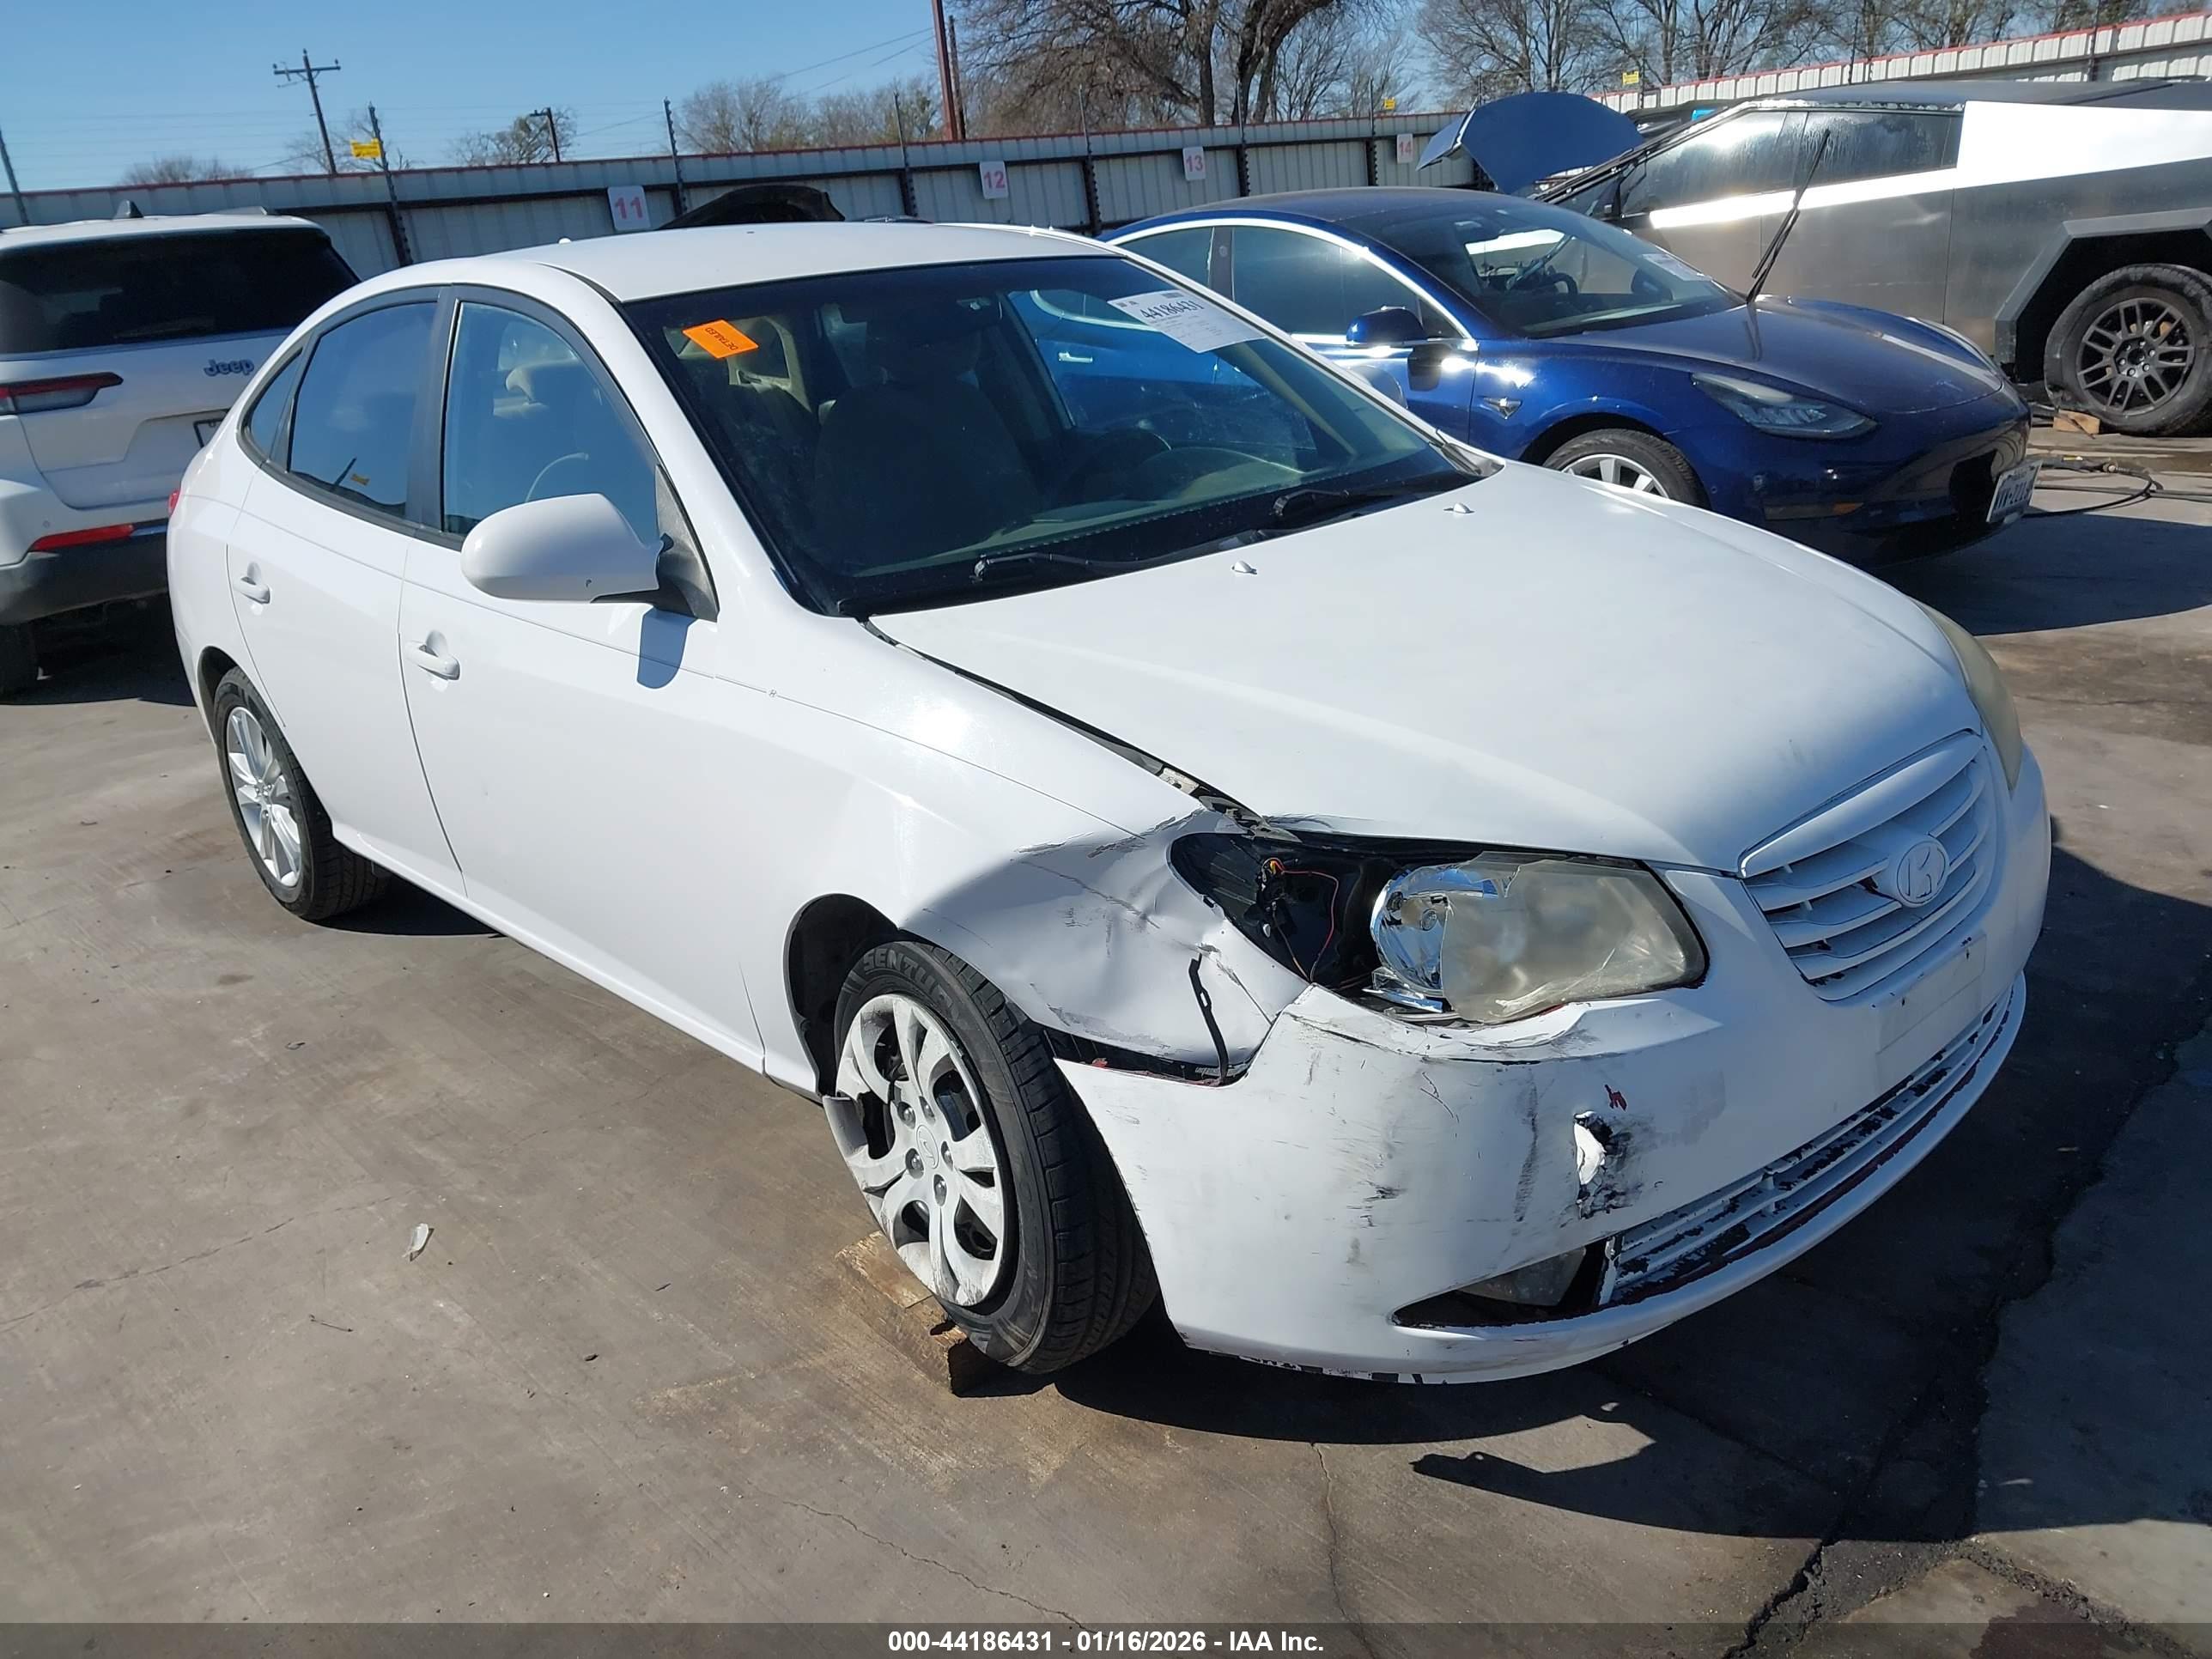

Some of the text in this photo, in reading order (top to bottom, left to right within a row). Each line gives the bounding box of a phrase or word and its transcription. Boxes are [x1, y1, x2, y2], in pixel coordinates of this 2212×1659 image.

[1186, 155, 1203, 173] 13
[983, 170, 1006, 189] 12
[615, 197, 643, 219] 11
[1139, 300, 1205, 319] 44186431
[704, 326, 738, 351] DETAILED
[204, 359, 255, 377] Jeep
